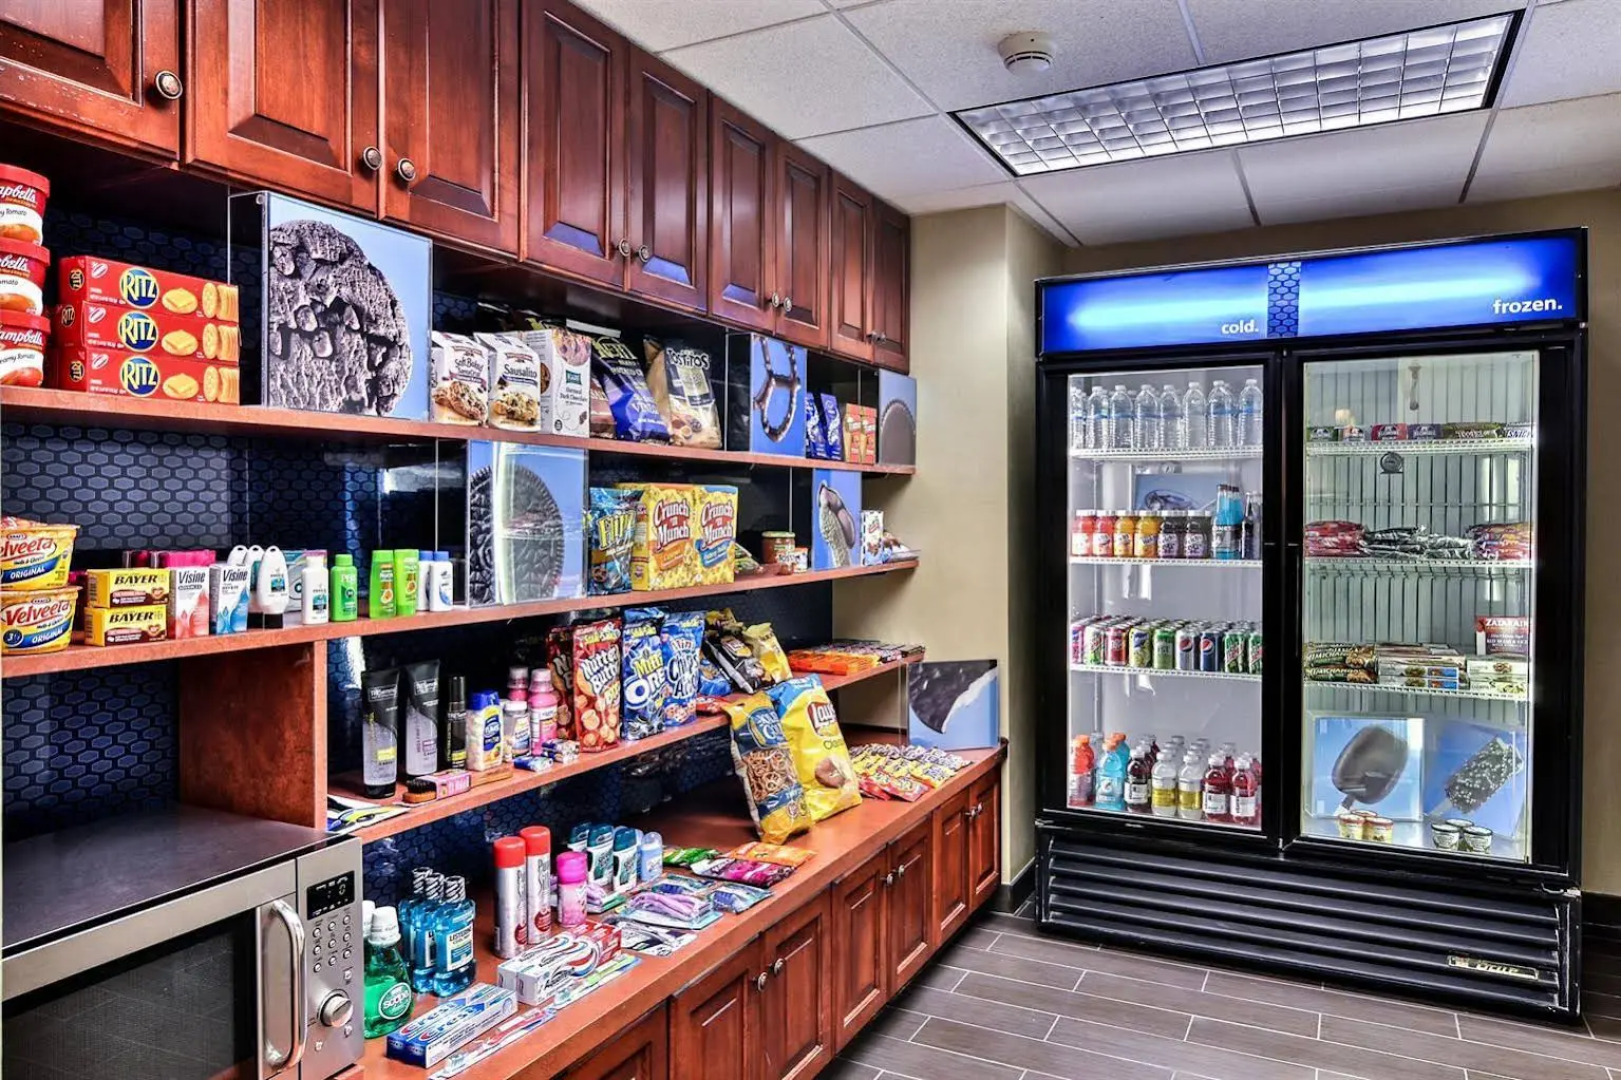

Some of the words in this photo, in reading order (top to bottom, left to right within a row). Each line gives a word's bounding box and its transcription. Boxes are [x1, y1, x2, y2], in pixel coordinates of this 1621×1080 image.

[124, 271, 156, 301] RITZ
[1492, 299, 1563, 315] frozen.
[121, 315, 155, 344] RITZ
[1221, 320, 1259, 334] cold.
[124, 361, 156, 390] RITZ
[504, 363, 538, 379] Sausalito
[653, 498, 690, 528] Crunch
[701, 500, 734, 528] Crunch
[656, 521, 690, 551] Munch
[701, 522, 733, 551] Munch
[10, 566, 45, 580] ORIGINAL
[115, 575, 158, 585] BAYER
[178, 570, 206, 584] Visine
[223, 569, 248, 582] Visine
[6, 600, 70, 626] Velveeta
[109, 612, 154, 623] BAYER
[32, 627, 63, 644] ORIGINAL
[625, 667, 666, 705] ORE
